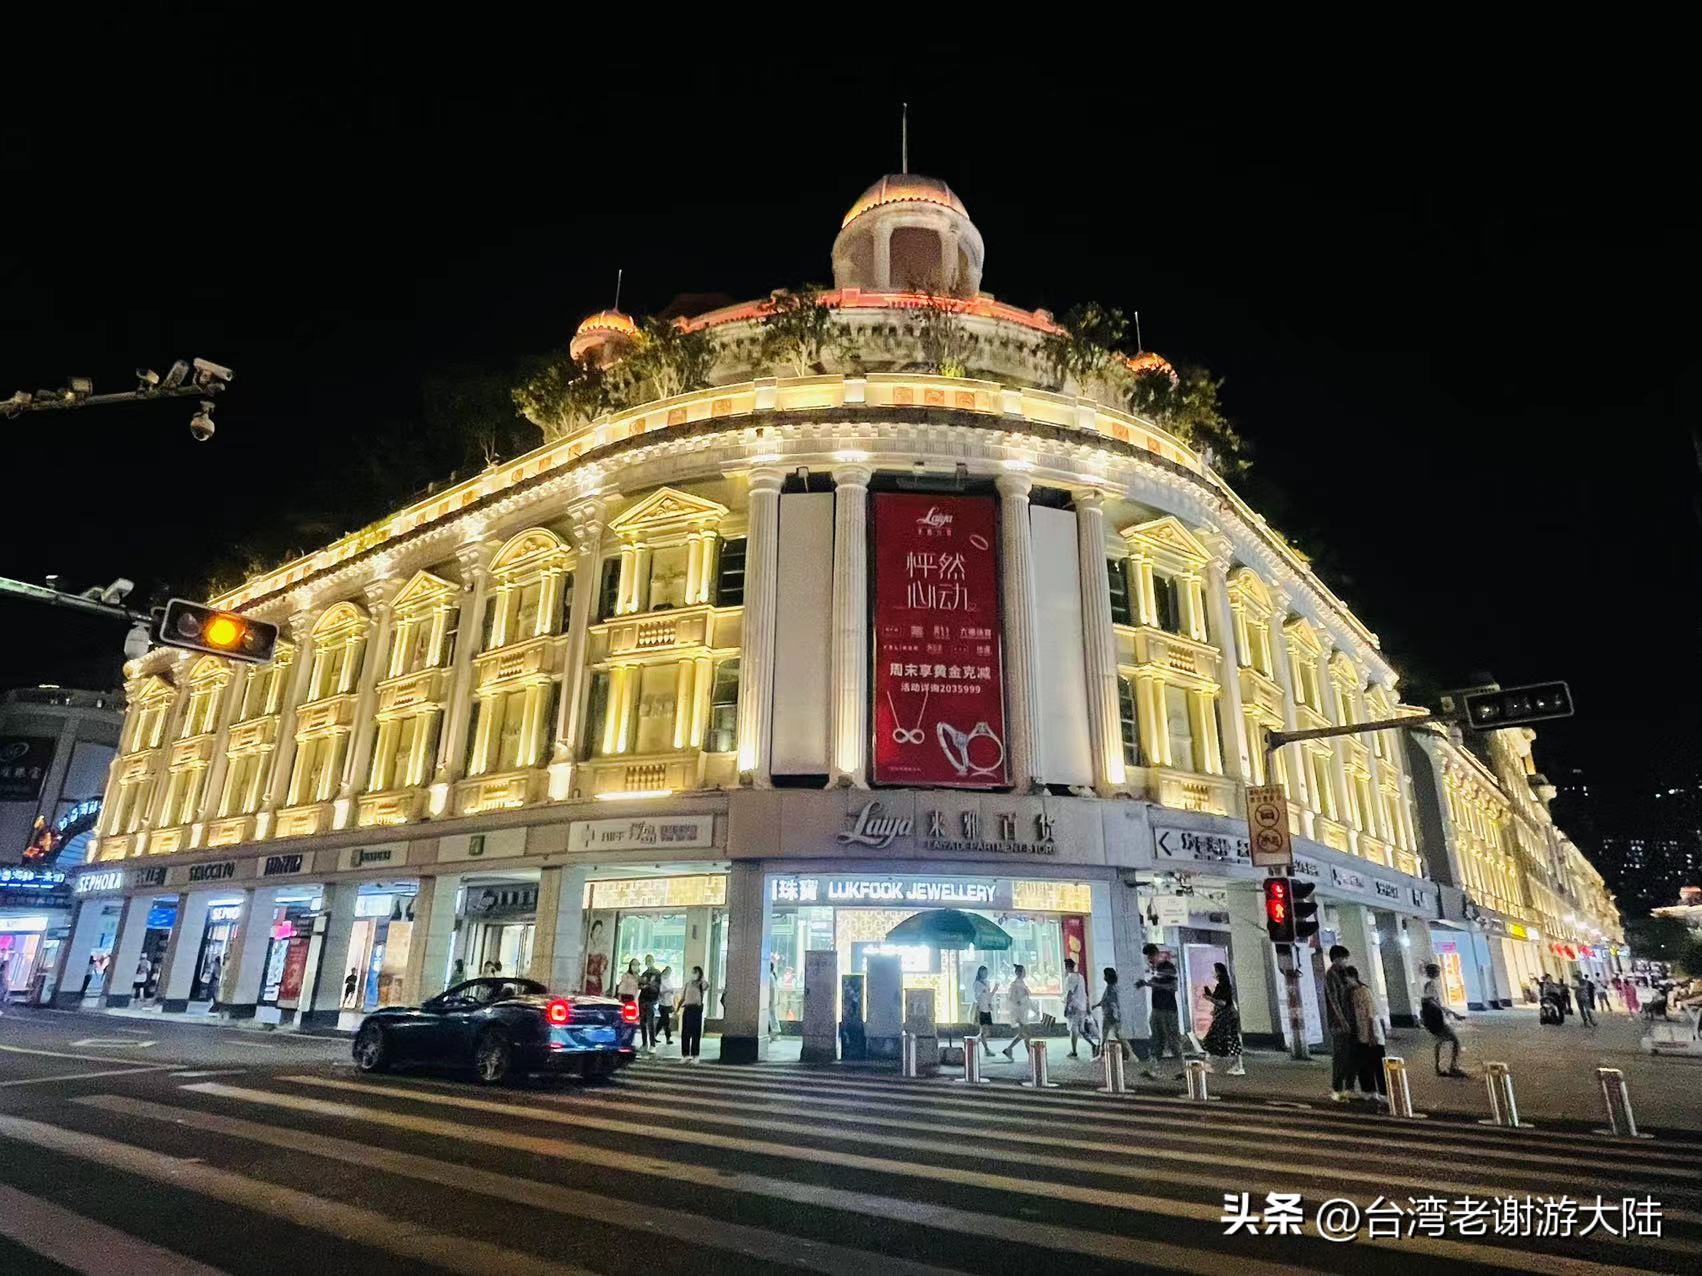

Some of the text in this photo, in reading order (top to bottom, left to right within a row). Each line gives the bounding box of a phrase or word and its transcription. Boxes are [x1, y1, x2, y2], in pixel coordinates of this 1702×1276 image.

[906, 551, 966, 580] 怦然
[907, 580, 968, 611] 心动
[889, 663, 991, 679] 周末享黄金克减
[77, 872, 122, 892] SEPHORA
[828, 881, 904, 900] LUKFOOK
[906, 882, 997, 902] JEWELLERY
